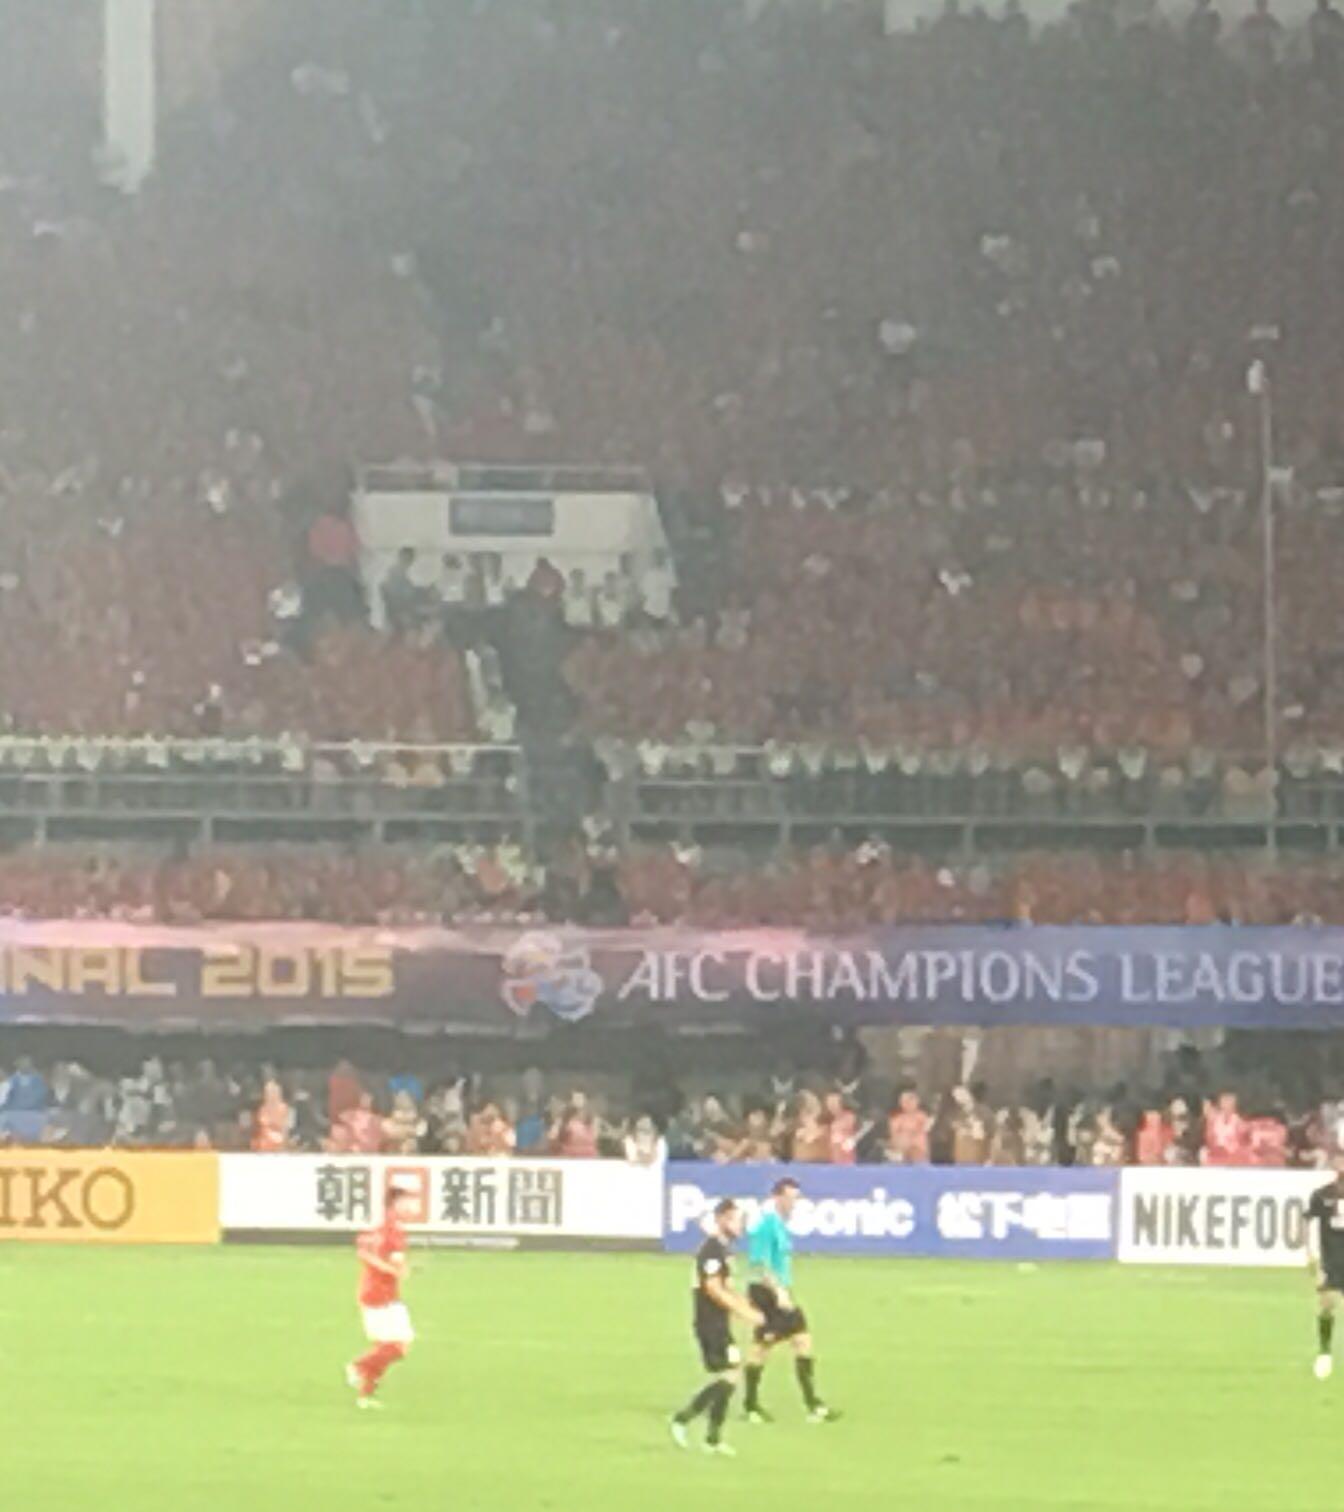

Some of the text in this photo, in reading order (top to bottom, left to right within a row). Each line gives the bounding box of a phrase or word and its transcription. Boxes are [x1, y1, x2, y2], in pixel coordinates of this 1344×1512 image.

[202, 945, 395, 997] 2015
[618, 951, 728, 1000] AFC
[744, 949, 1102, 1003] CHAMPIONS
[1119, 951, 1344, 1004] LEAGUE
